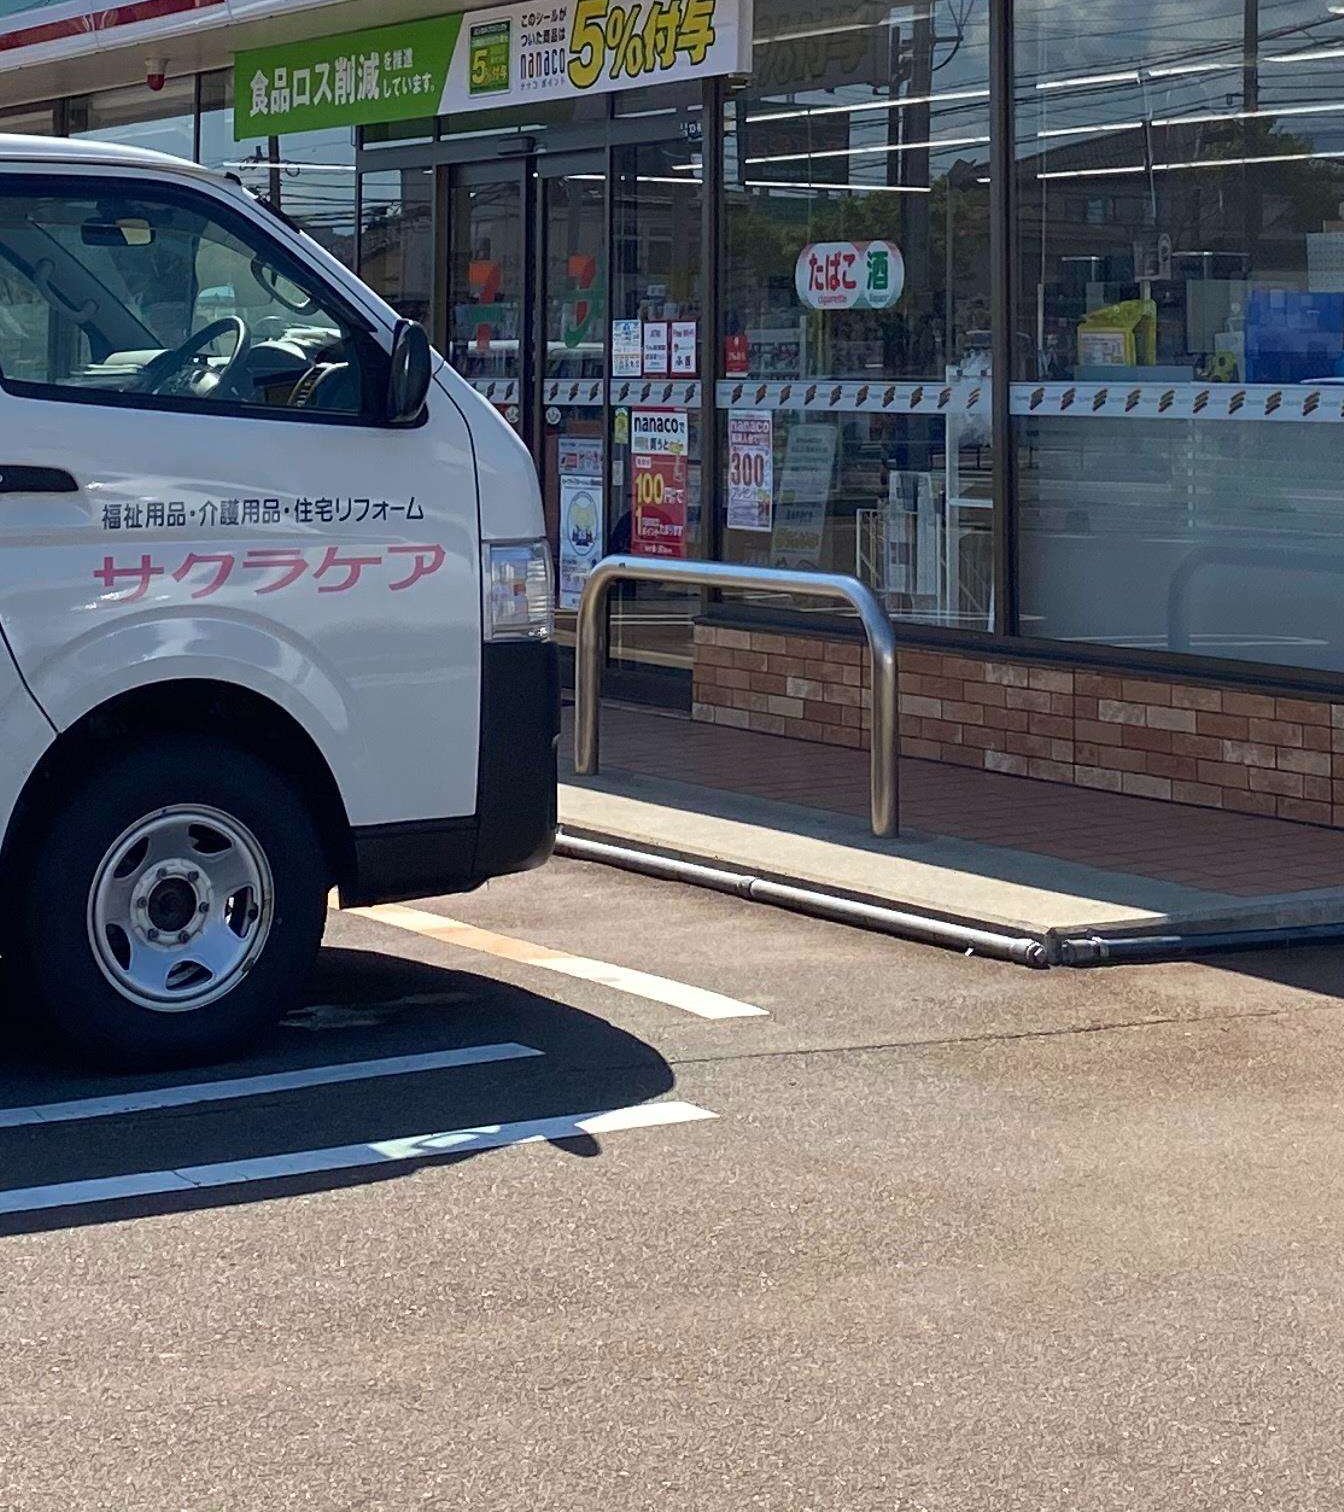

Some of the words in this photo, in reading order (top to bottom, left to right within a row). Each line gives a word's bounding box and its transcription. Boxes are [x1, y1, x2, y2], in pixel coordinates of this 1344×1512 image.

[521, 6, 567, 28] このシールが
[520, 47, 566, 79] nanaco
[249, 51, 380, 118] 食品ロス削減
[808, 251, 858, 291] たばこ
[866, 250, 889, 290] 酒
[730, 452, 765, 487] 300
[93, 543, 446, 604] サクラケア
